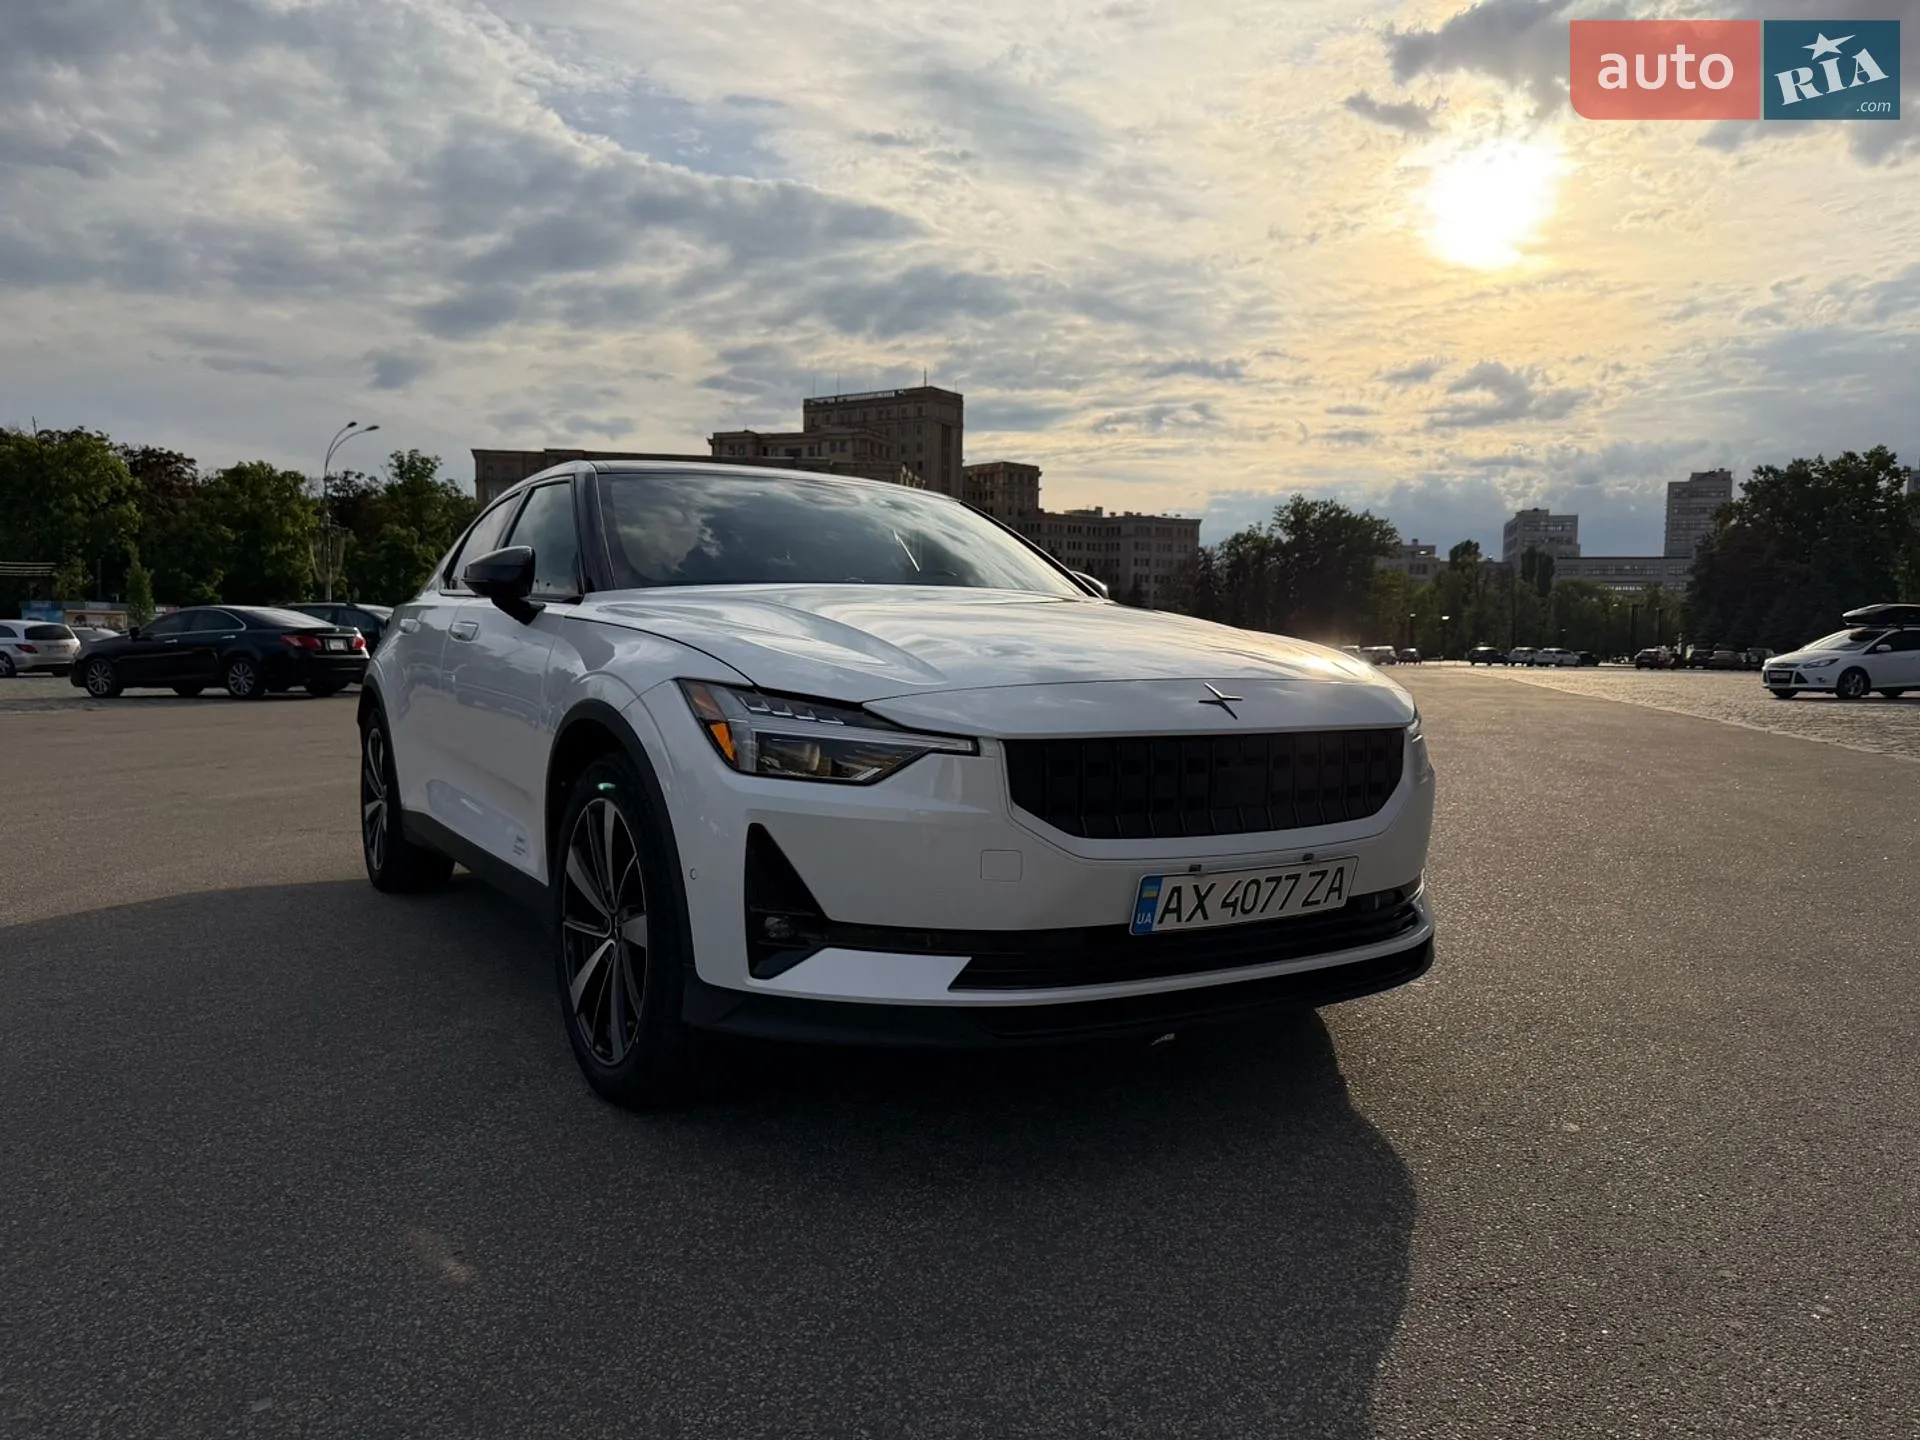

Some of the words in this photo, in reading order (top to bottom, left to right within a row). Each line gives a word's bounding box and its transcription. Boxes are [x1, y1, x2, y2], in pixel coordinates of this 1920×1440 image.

[1158, 882, 1216, 924] AX
[1220, 873, 1301, 917] 4077
[1301, 866, 1345, 908] ZA
[1137, 915, 1152, 925] UA
